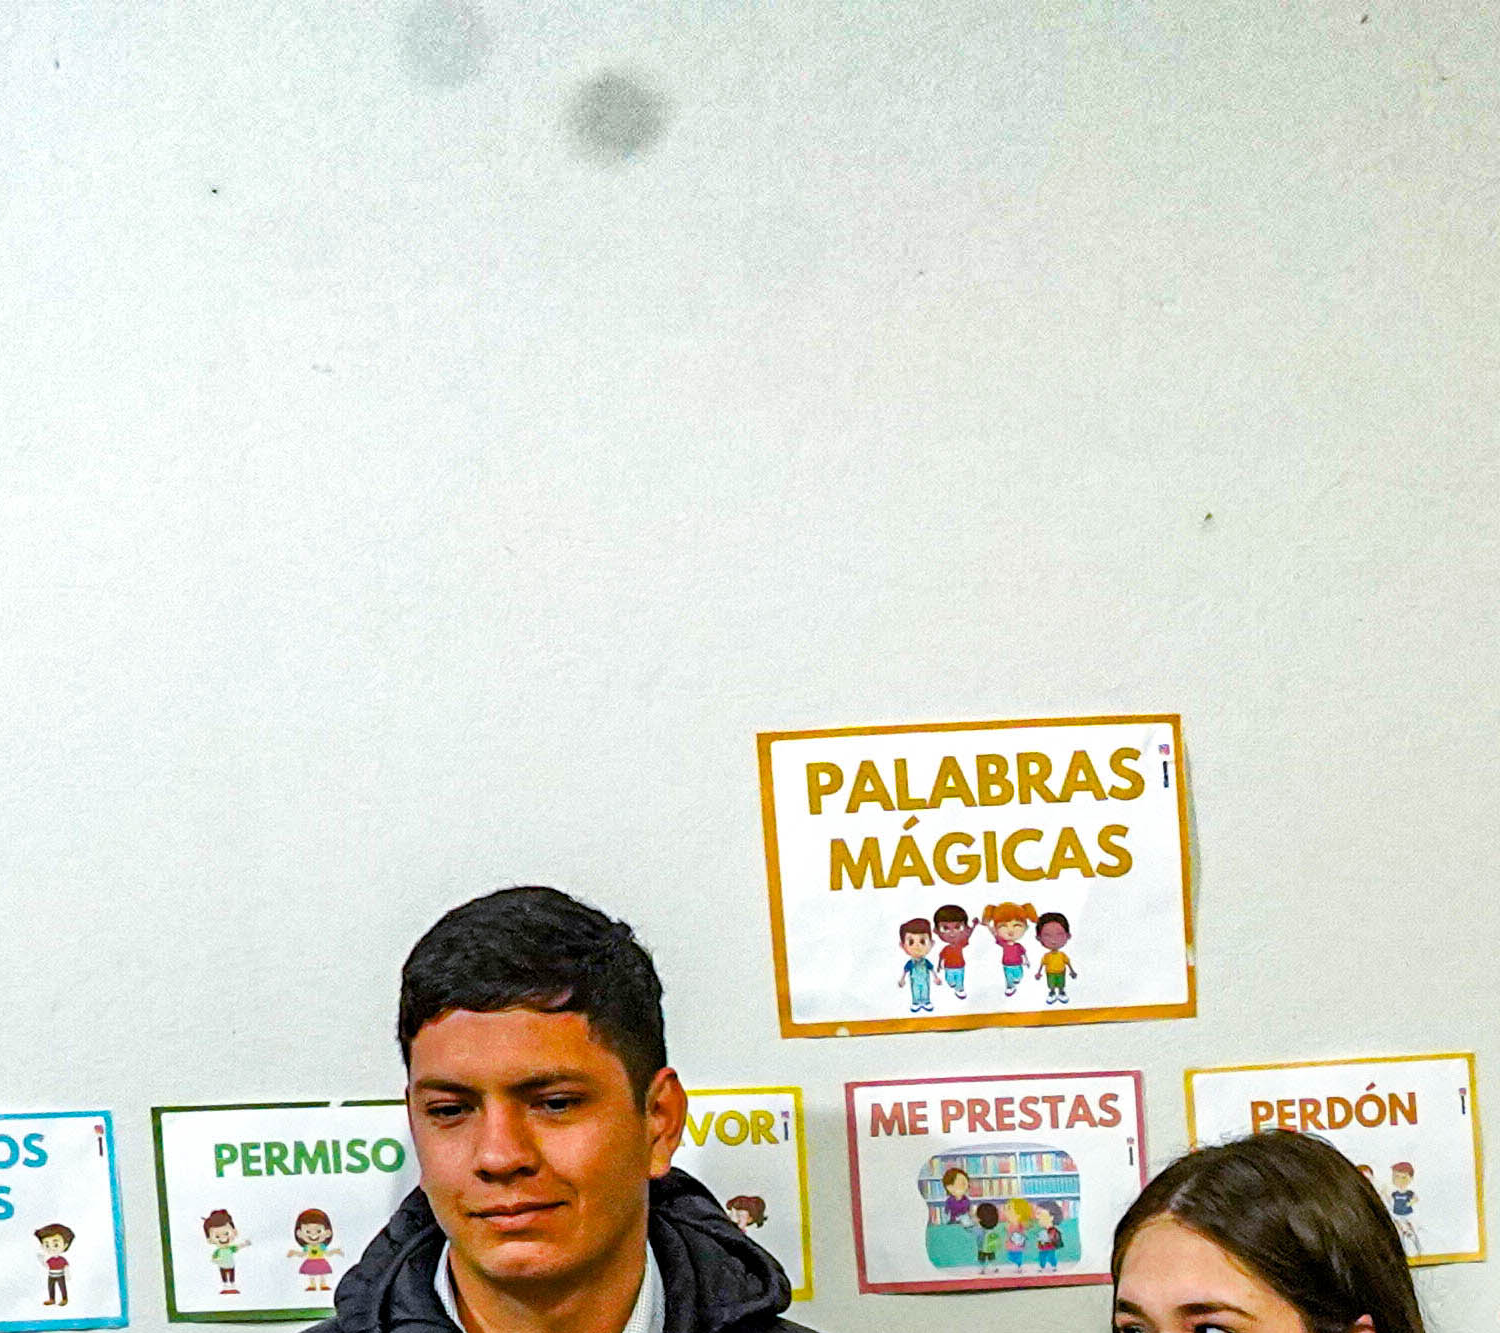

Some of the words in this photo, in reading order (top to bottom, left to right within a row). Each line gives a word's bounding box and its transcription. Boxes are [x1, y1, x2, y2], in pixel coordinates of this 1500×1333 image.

[805, 747, 1145, 815] PALABRAS
[828, 816, 1133, 891] MÁGICAS
[682, 1109, 780, 1147] VOR
[869, 1101, 929, 1138] ME
[941, 1093, 1122, 1133] PRESTAS
[1251, 1083, 1418, 1131] PERDÓN
[213, 1137, 406, 1179] PERMISO
